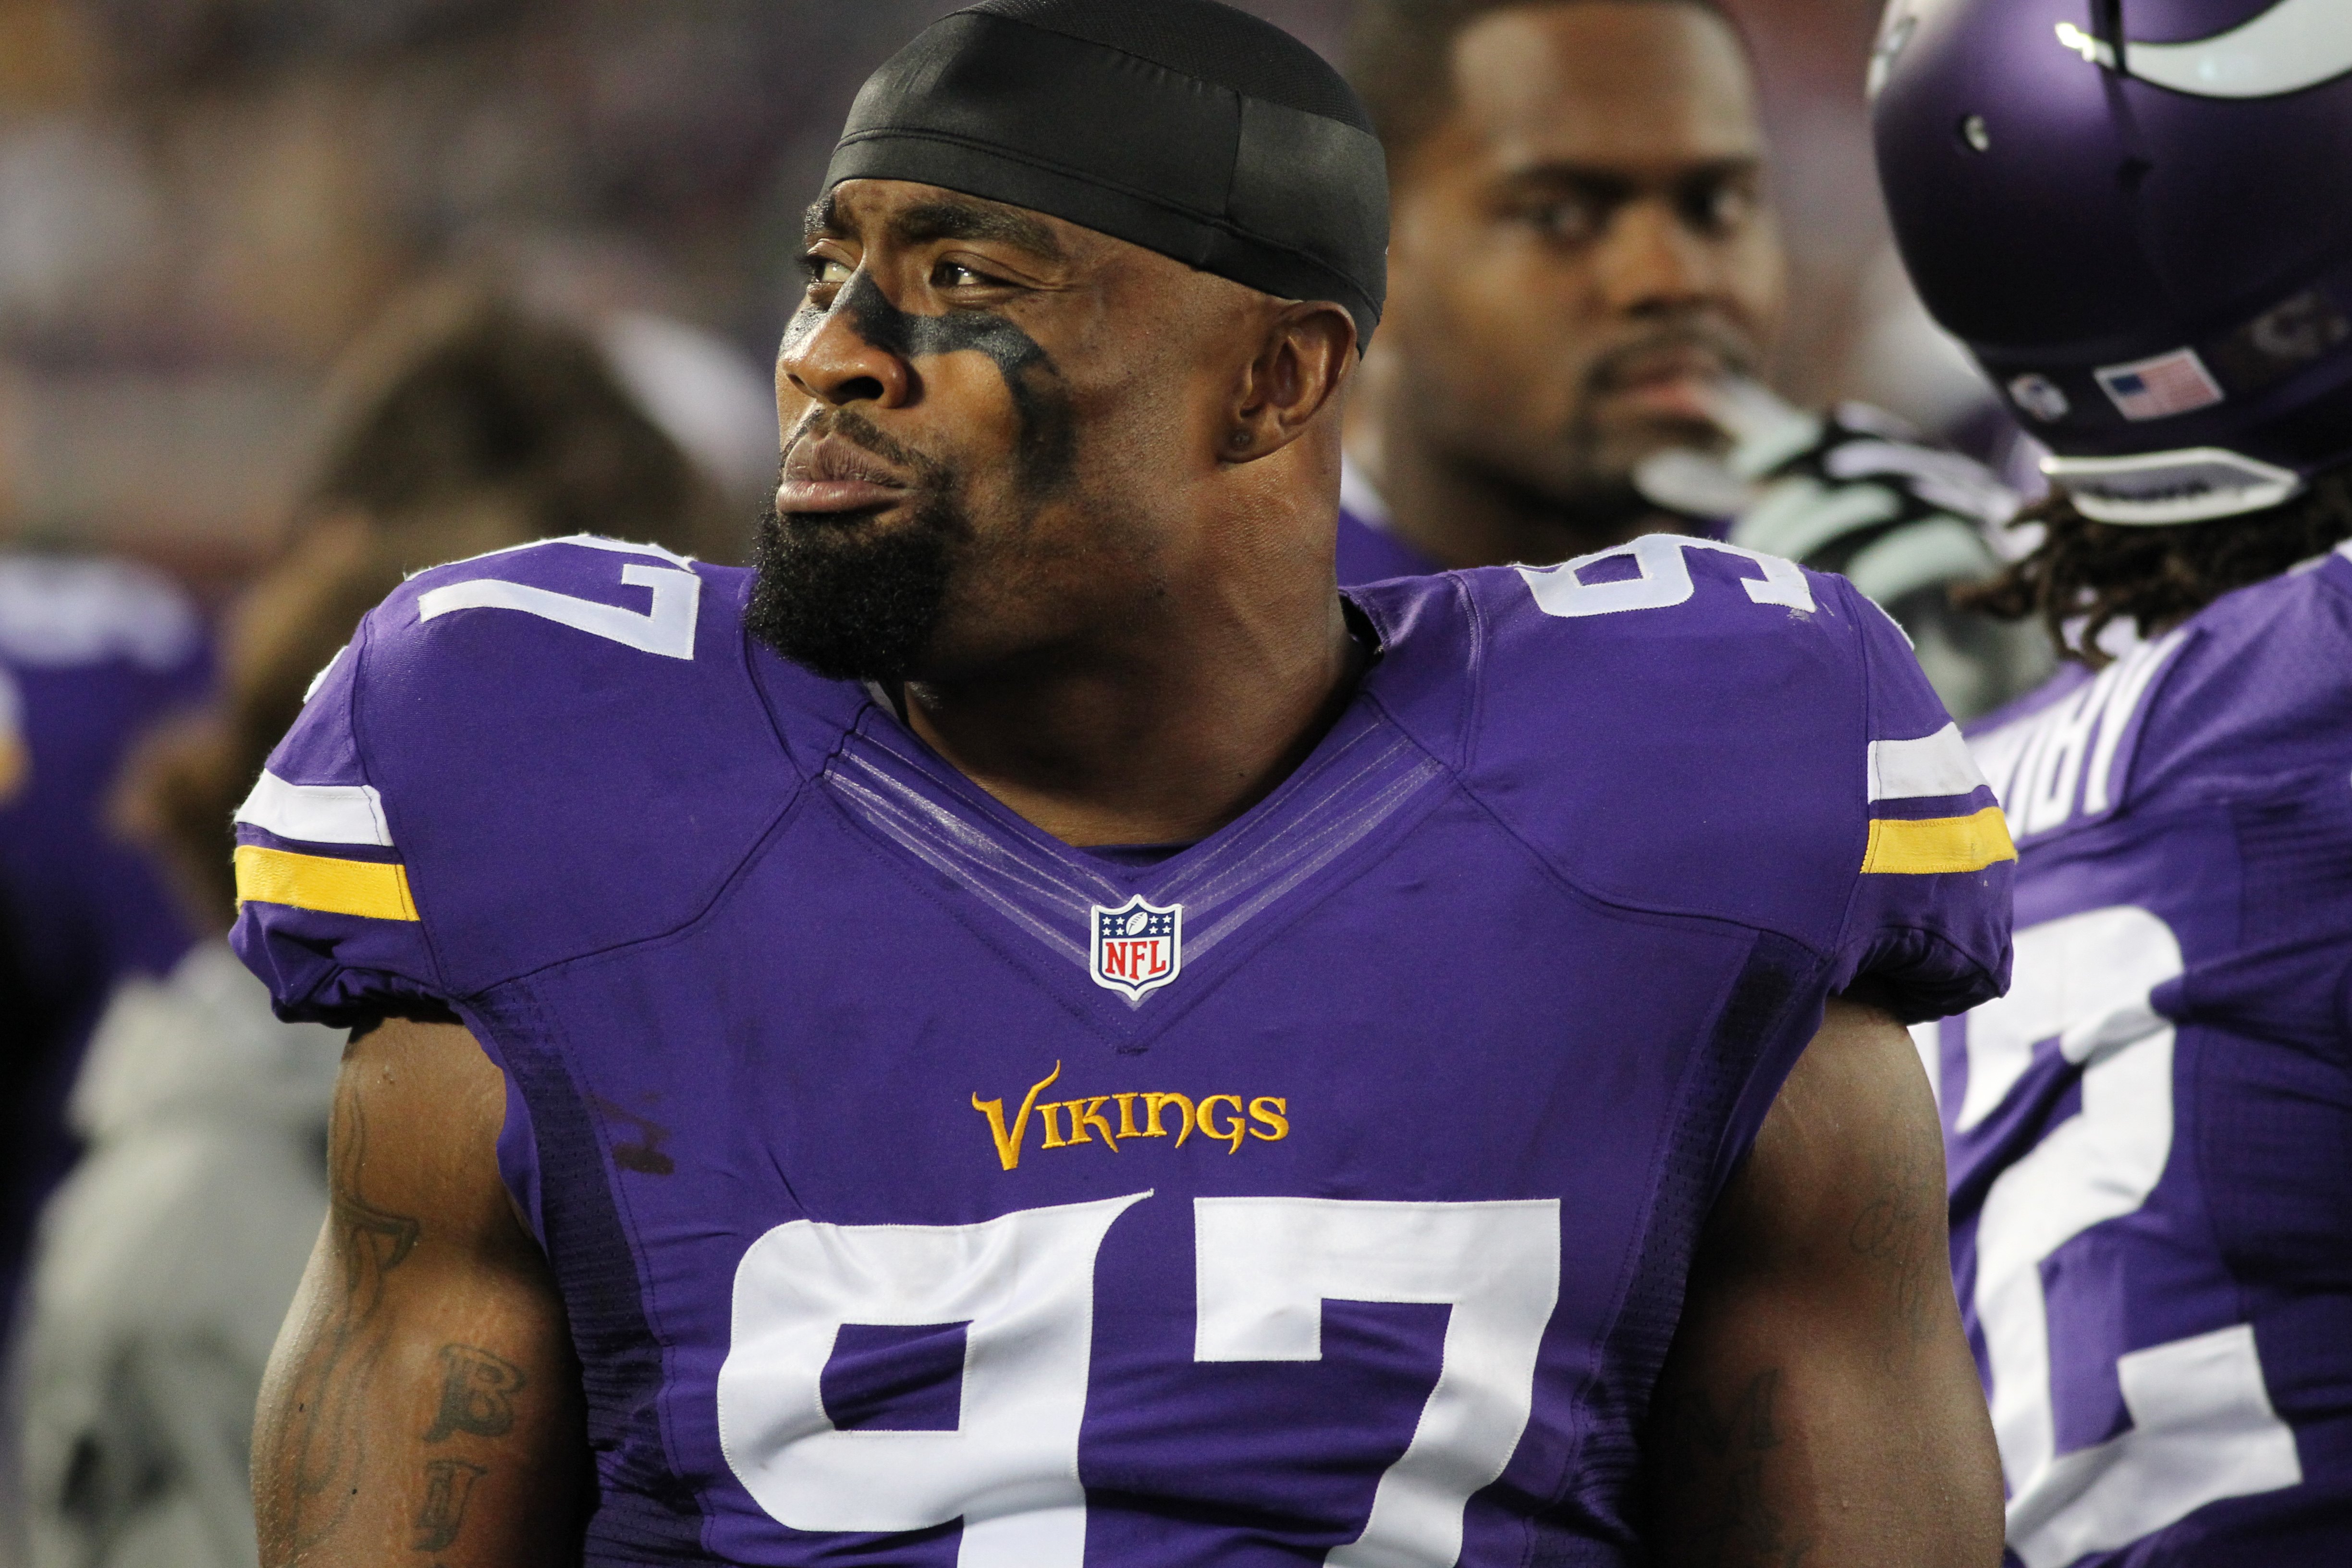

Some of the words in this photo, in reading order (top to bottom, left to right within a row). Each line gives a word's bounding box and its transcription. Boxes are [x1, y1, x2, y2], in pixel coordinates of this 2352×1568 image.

[1105, 940, 1166, 980] NFL
[972, 1059, 1289, 1171] VIKINGS
[1906, 905, 2303, 1568] 2
[717, 1188, 1561, 1568] 97
